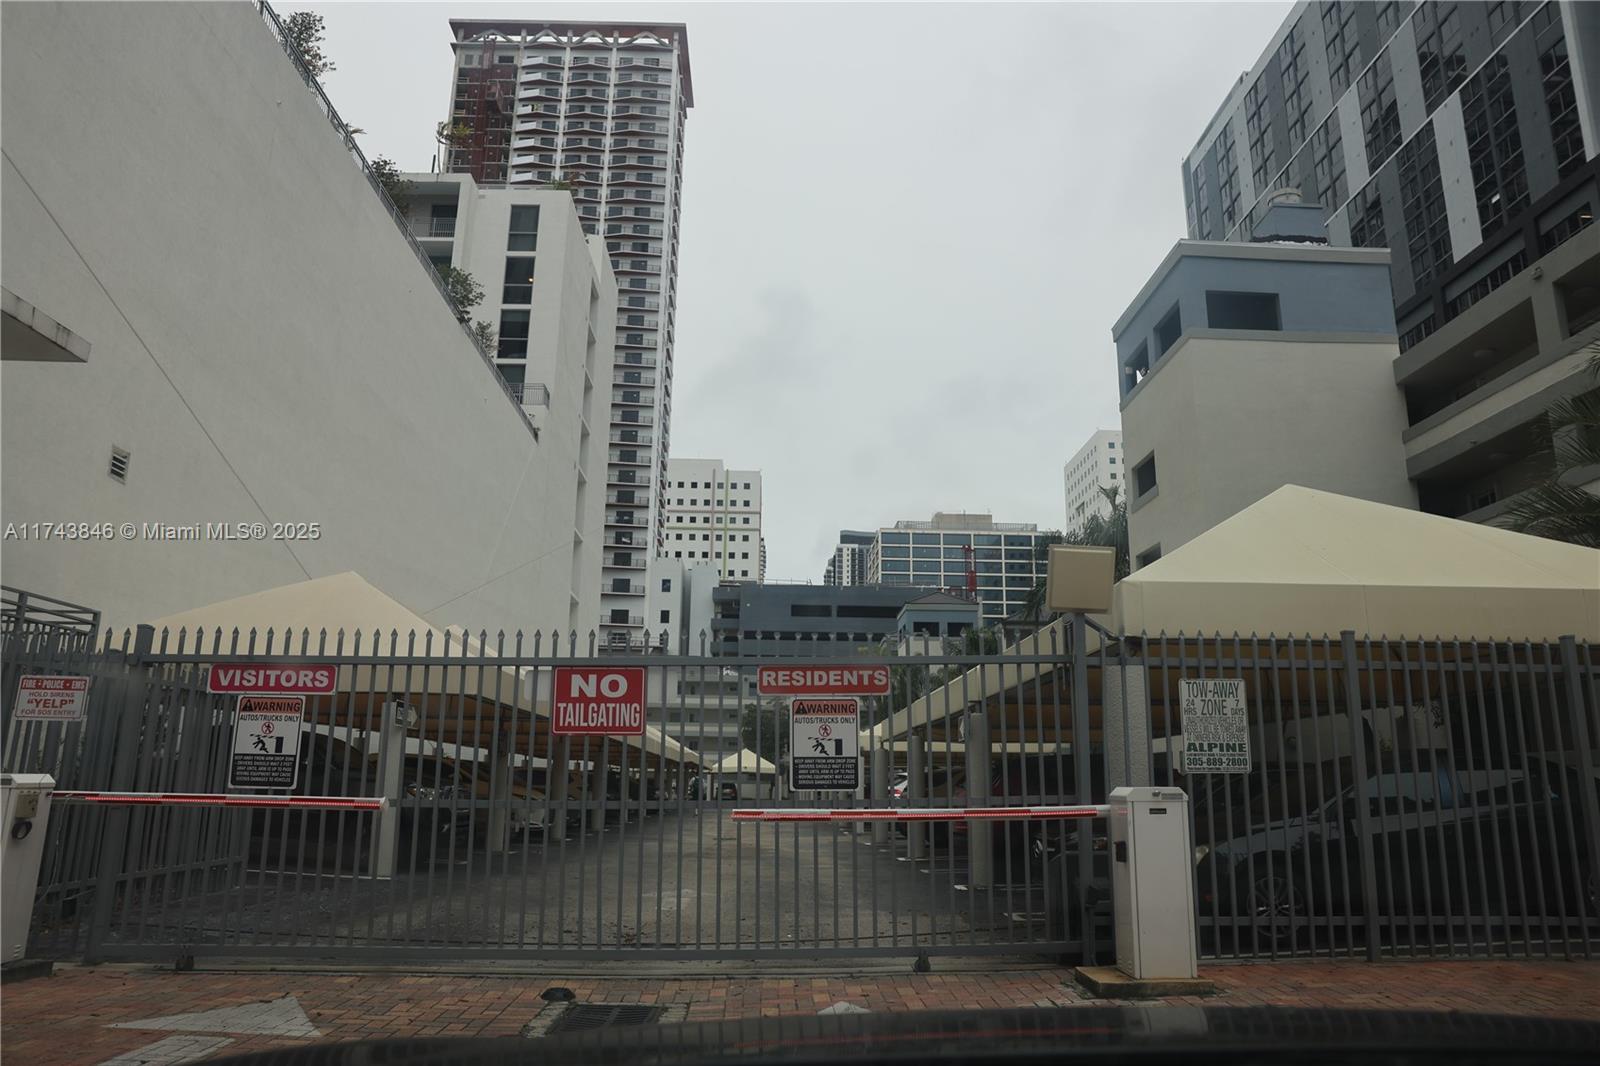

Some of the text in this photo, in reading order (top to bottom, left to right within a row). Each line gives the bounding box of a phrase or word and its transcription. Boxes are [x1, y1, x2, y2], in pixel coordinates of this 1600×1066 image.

[22, 679, 86, 689] FIRE POLICE EMS
[218, 669, 329, 687] VISITORS
[762, 670, 887, 686] RESIDENTS
[570, 674, 628, 698] NO
[1185, 681, 1240, 698] TOW-AWAY
[253, 701, 300, 712] WARNING
[806, 703, 856, 713] WARNING
[1184, 707, 1244, 716] HRS DAYS
[1200, 699, 1228, 716] ZONE
[558, 702, 640, 727] TAILGATING
[1186, 742, 1247, 752] ALPINE
[1186, 757, 1248, 767] 305-889-2800
